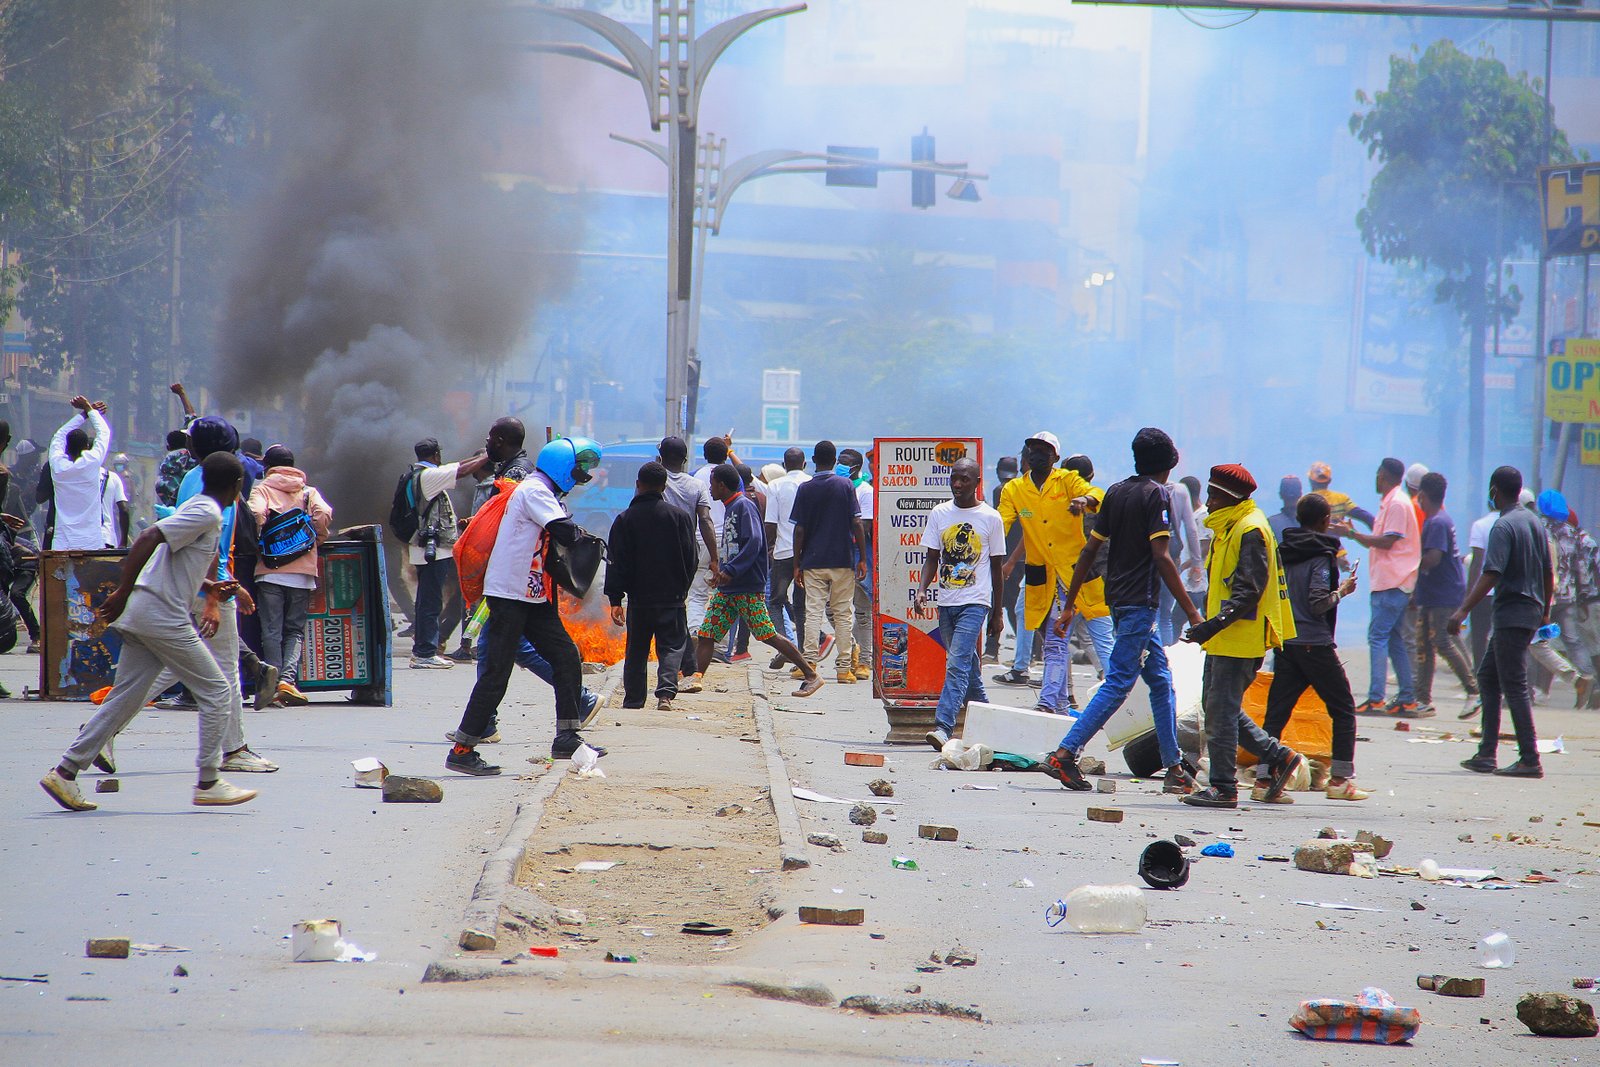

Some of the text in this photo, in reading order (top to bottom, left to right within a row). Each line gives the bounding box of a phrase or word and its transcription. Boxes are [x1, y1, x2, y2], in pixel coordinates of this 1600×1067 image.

[895, 447, 935, 461] ROUTE
[887, 464, 913, 475] KMO
[932, 465, 952, 474] DIGI
[882, 476, 918, 487] SACCO
[899, 499, 937, 509] New Route
[324, 619, 342, 679] 2039603
